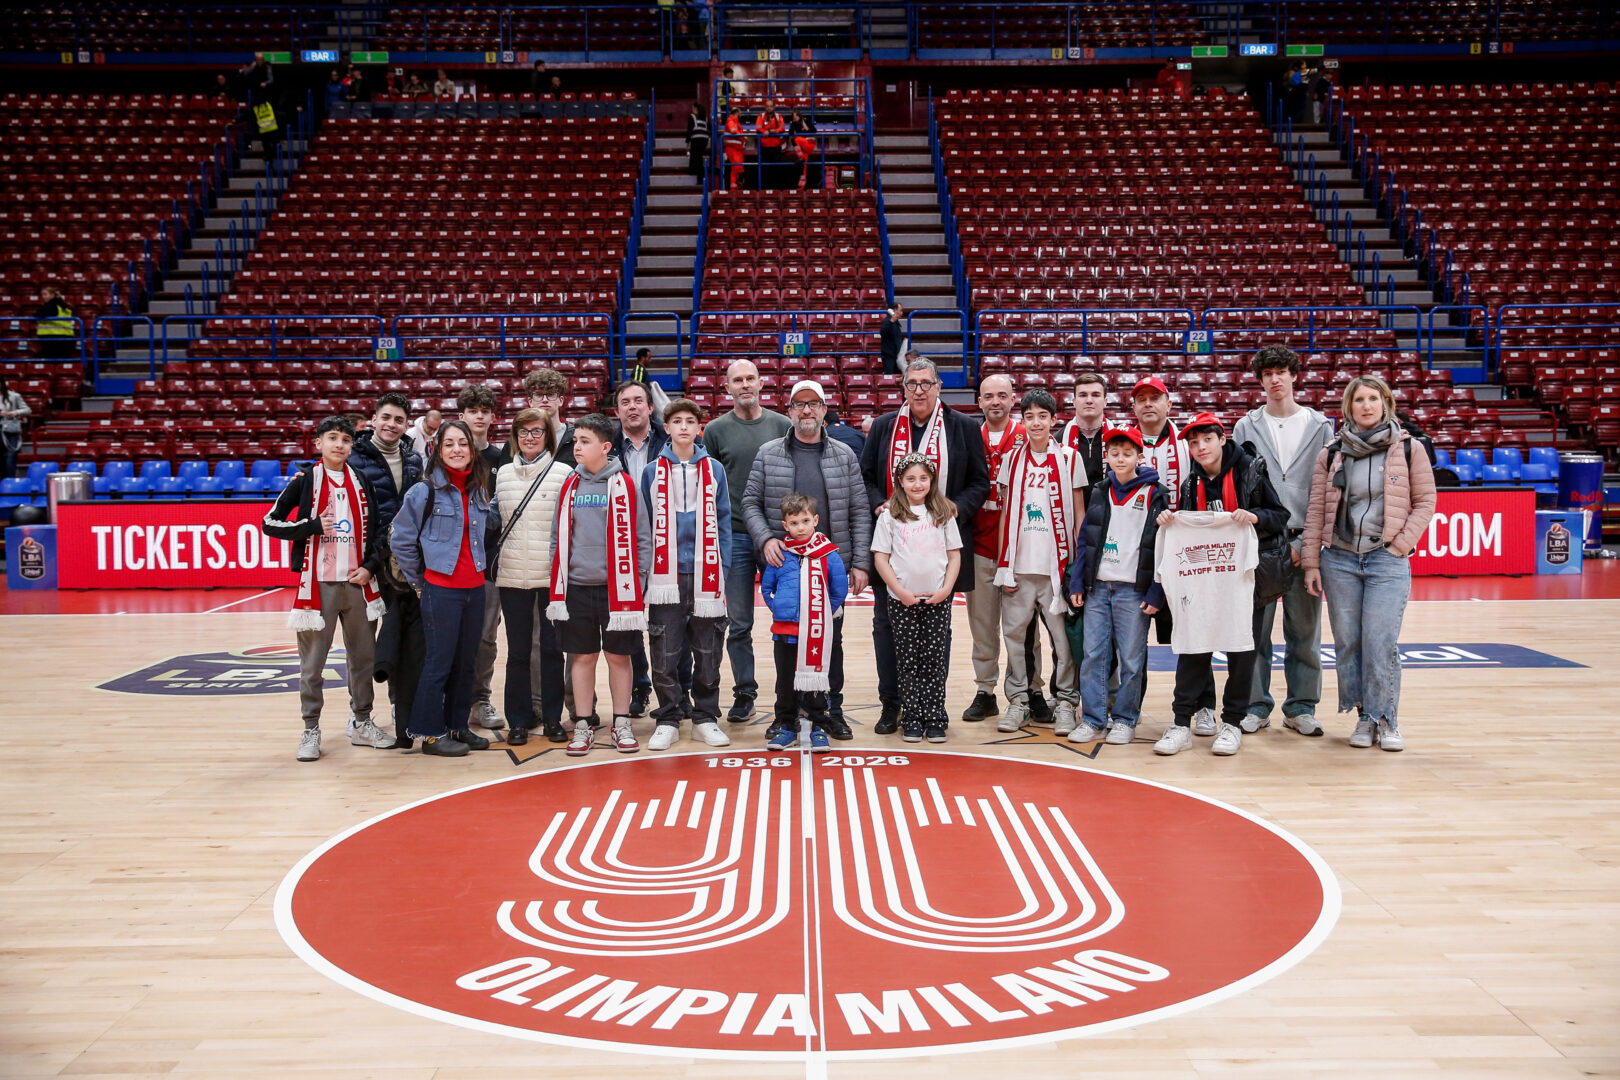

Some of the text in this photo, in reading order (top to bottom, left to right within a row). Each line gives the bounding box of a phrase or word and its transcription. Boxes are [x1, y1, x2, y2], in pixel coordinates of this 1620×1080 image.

[1250, 46, 1268, 54] BAR
[310, 52, 329, 61] BAR
[1192, 332, 1204, 340] 22
[380, 340, 392, 348] 20
[1028, 473, 1046, 488] 22
[656, 466, 666, 548] OLIMPIA
[706, 484, 718, 564] OLIMPIA
[1050, 482, 1068, 560] OLIMPIA
[616, 495, 630, 574] OLIMPIA
[1186, 544, 1210, 552] OLIMPIA
[1207, 548, 1234, 561] EA7
[1179, 567, 1212, 576] PLAYOFF
[810, 559, 822, 638] OLIMPIA
[146, 669, 344, 681] LBA
[704, 756, 910, 768] 1936 2026
[455, 948, 1170, 1037] OLIMPIA MILANO
